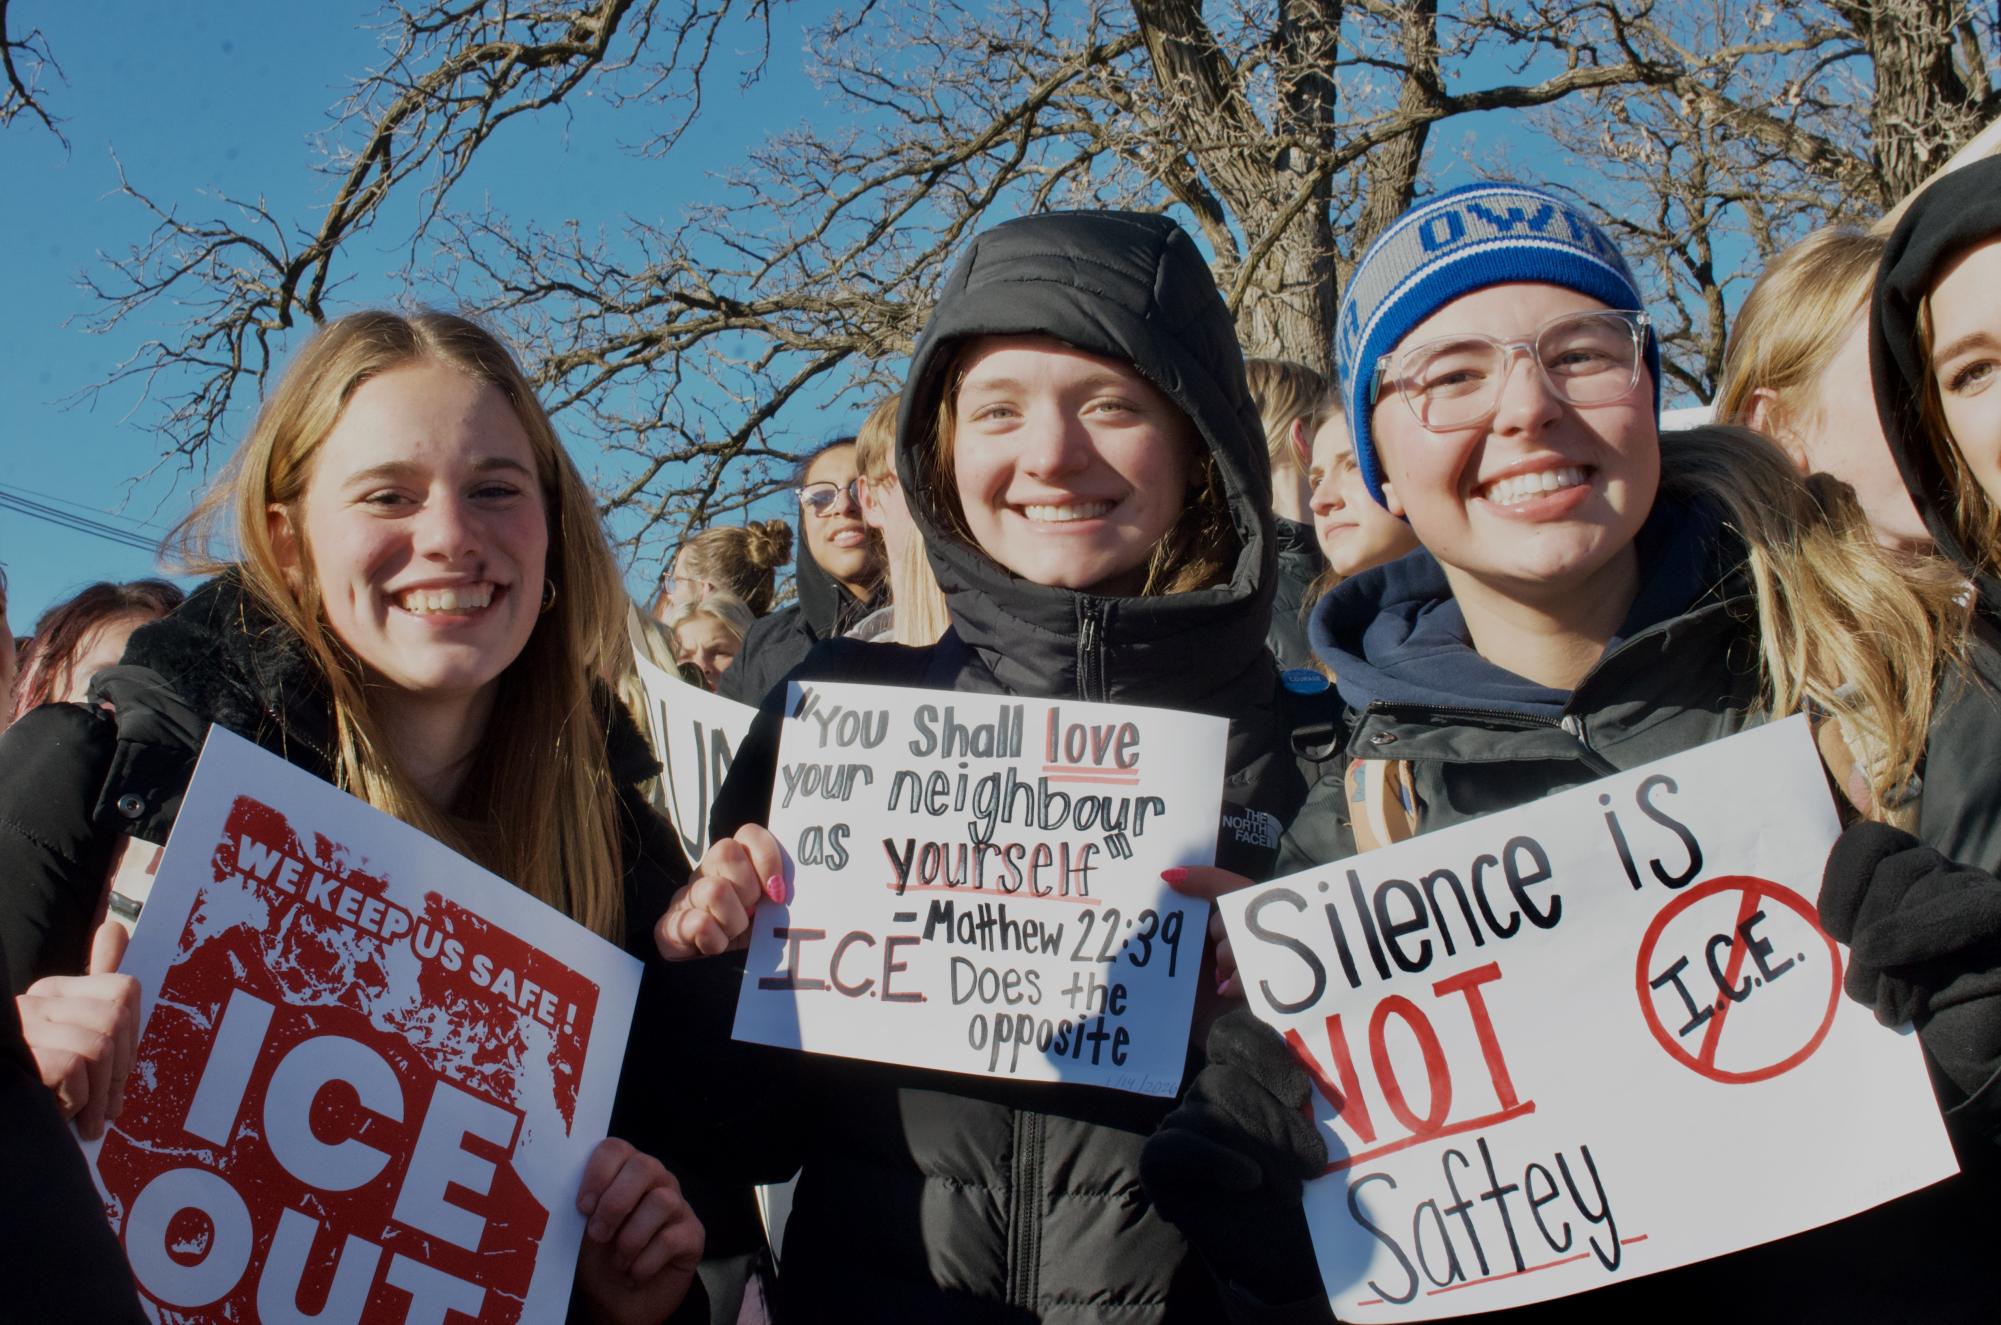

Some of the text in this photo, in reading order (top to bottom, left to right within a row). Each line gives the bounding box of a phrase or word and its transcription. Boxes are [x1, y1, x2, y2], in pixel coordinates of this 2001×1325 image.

[908, 704, 1024, 759] Shall
[1046, 706, 1140, 769] love
[782, 762, 1165, 845] your neighbour
[798, 822, 850, 871] as
[1222, 815, 1267, 836] NORTH
[1235, 829, 1267, 847] FACE
[1244, 807, 1268, 825] THE
[237, 834, 304, 894] WE
[305, 871, 411, 941] KEEP
[414, 923, 465, 972] US
[1070, 907, 1184, 977] 22:39
[1244, 836, 1563, 1014] Silence
[758, 927, 1128, 1016] I.C.E. Does the
[1649, 910, 1805, 1037] I.C.E.
[968, 1012, 1130, 1073] opposite
[1284, 961, 1521, 1144] NOT
[184, 988, 518, 1254] ICE
[125, 1167, 487, 1325] OUT
[1347, 1137, 1621, 1304] Saftey
